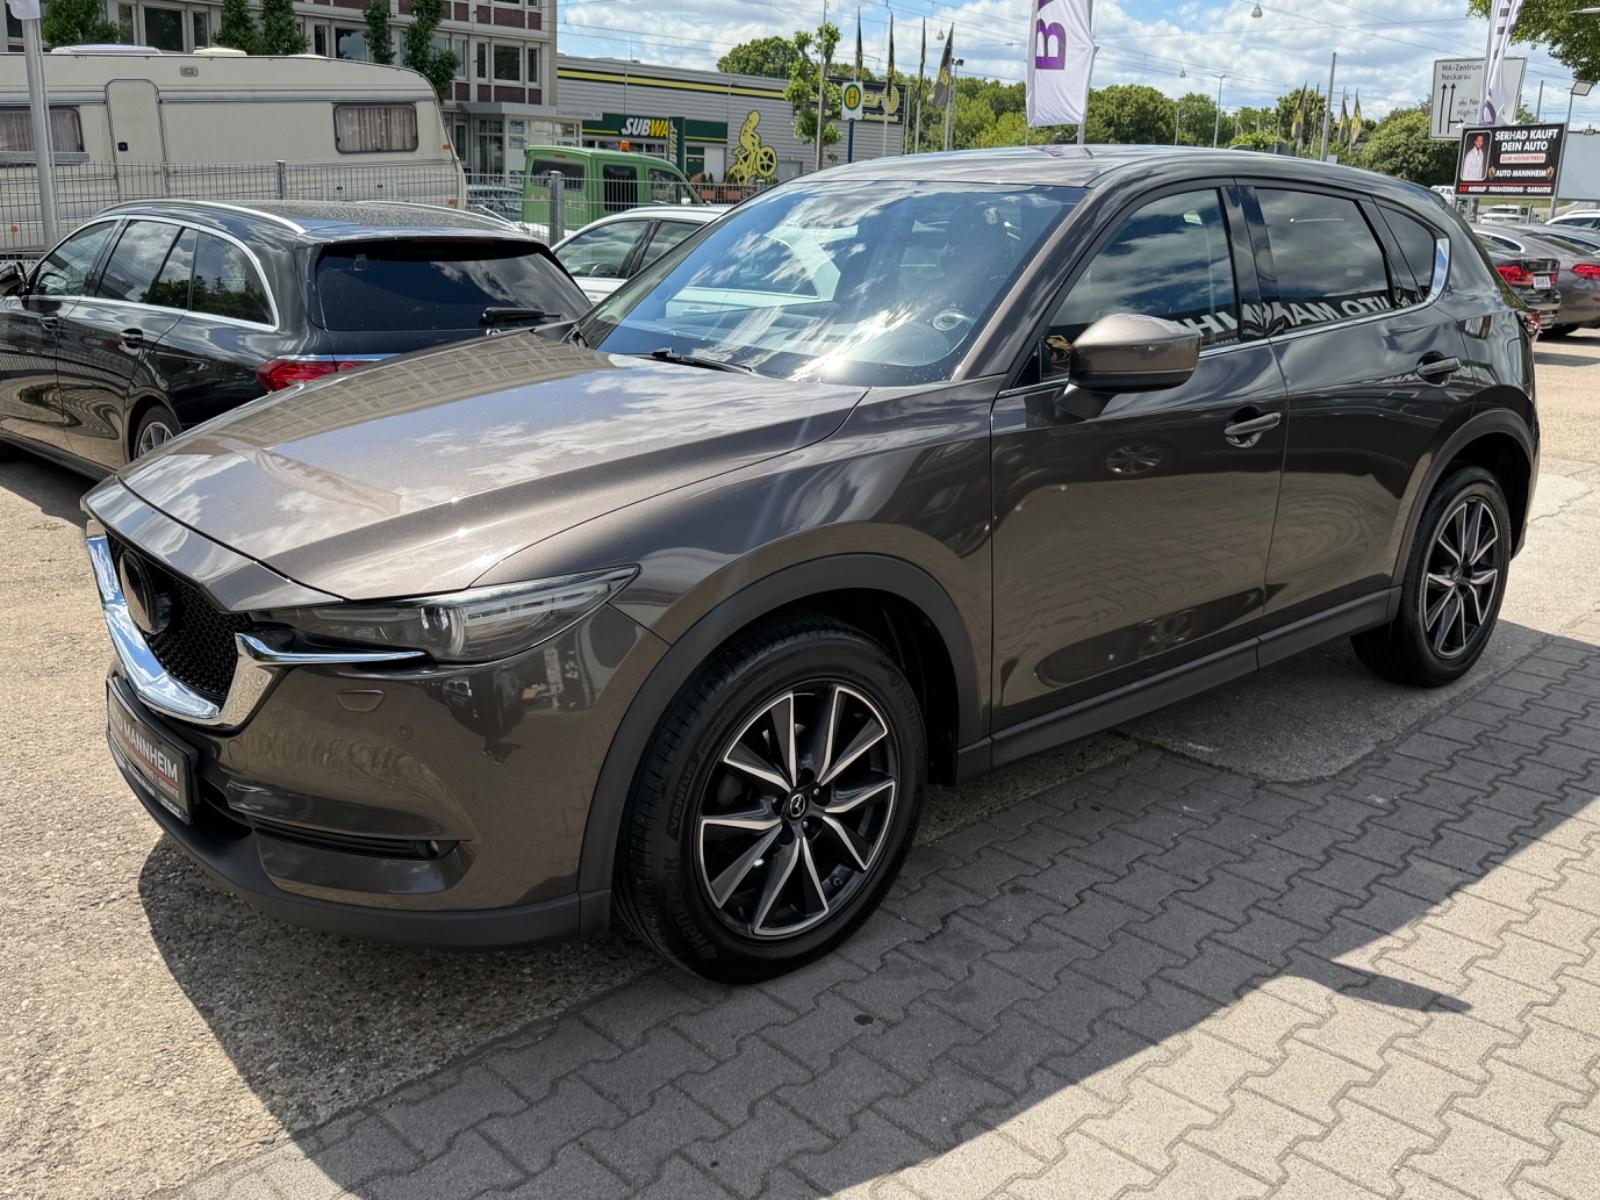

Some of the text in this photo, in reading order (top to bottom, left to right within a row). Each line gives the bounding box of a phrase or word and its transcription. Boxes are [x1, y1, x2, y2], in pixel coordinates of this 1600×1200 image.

[1441, 73, 1472, 81] Neckarau
[621, 117, 669, 137] SUBWA
[1495, 128, 1559, 141] SERHAD KAUFT
[1501, 141, 1548, 152] DEIN AUTO
[1495, 169, 1547, 177] AUTO MANNHEIM
[123, 719, 178, 784] MANNHEIM
